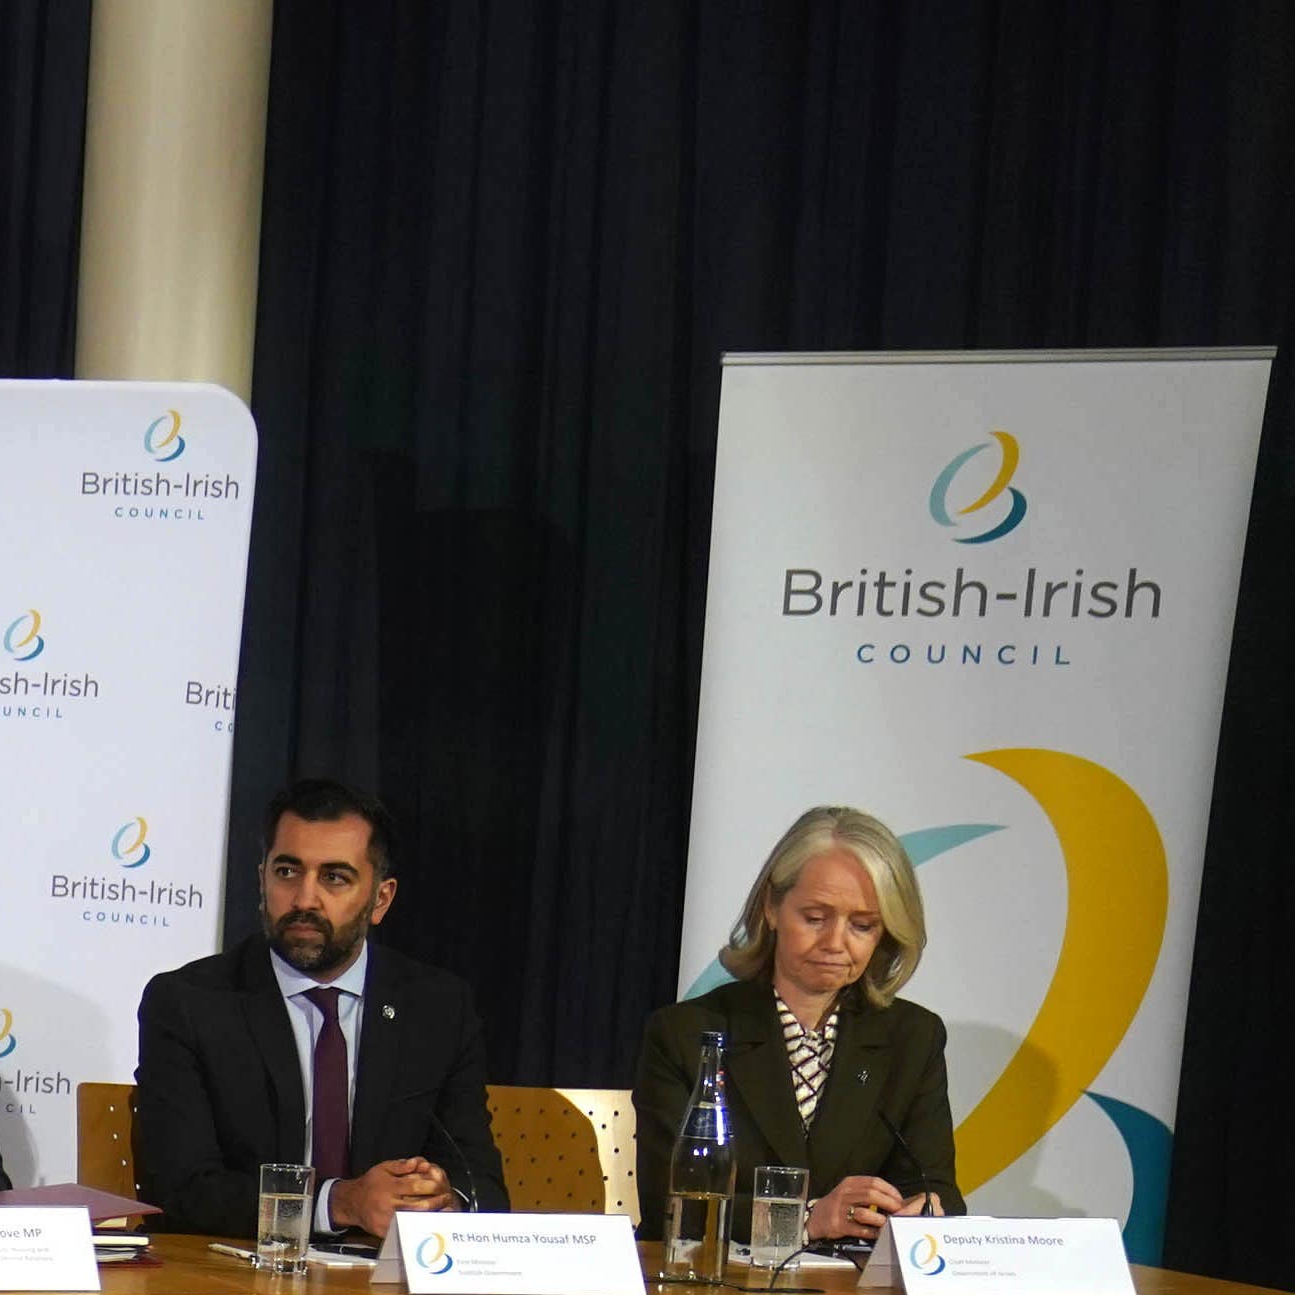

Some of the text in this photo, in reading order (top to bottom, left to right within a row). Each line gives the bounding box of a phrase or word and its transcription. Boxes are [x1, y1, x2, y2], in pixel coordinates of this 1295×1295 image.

[80, 471, 240, 501] British-Irish
[113, 506, 205, 521] COUNCIL
[781, 567, 1162, 620] British-Irish
[855, 643, 1071, 667] COUNCIL
[50, 874, 204, 909] British-Irish
[82, 911, 170, 928] COUNCIL
[23, 1228, 43, 1239] MP
[452, 1232, 597, 1245] Rt Hon Humza Yousaf MSP
[943, 1234, 1064, 1247] Deputy Kristina Moore
